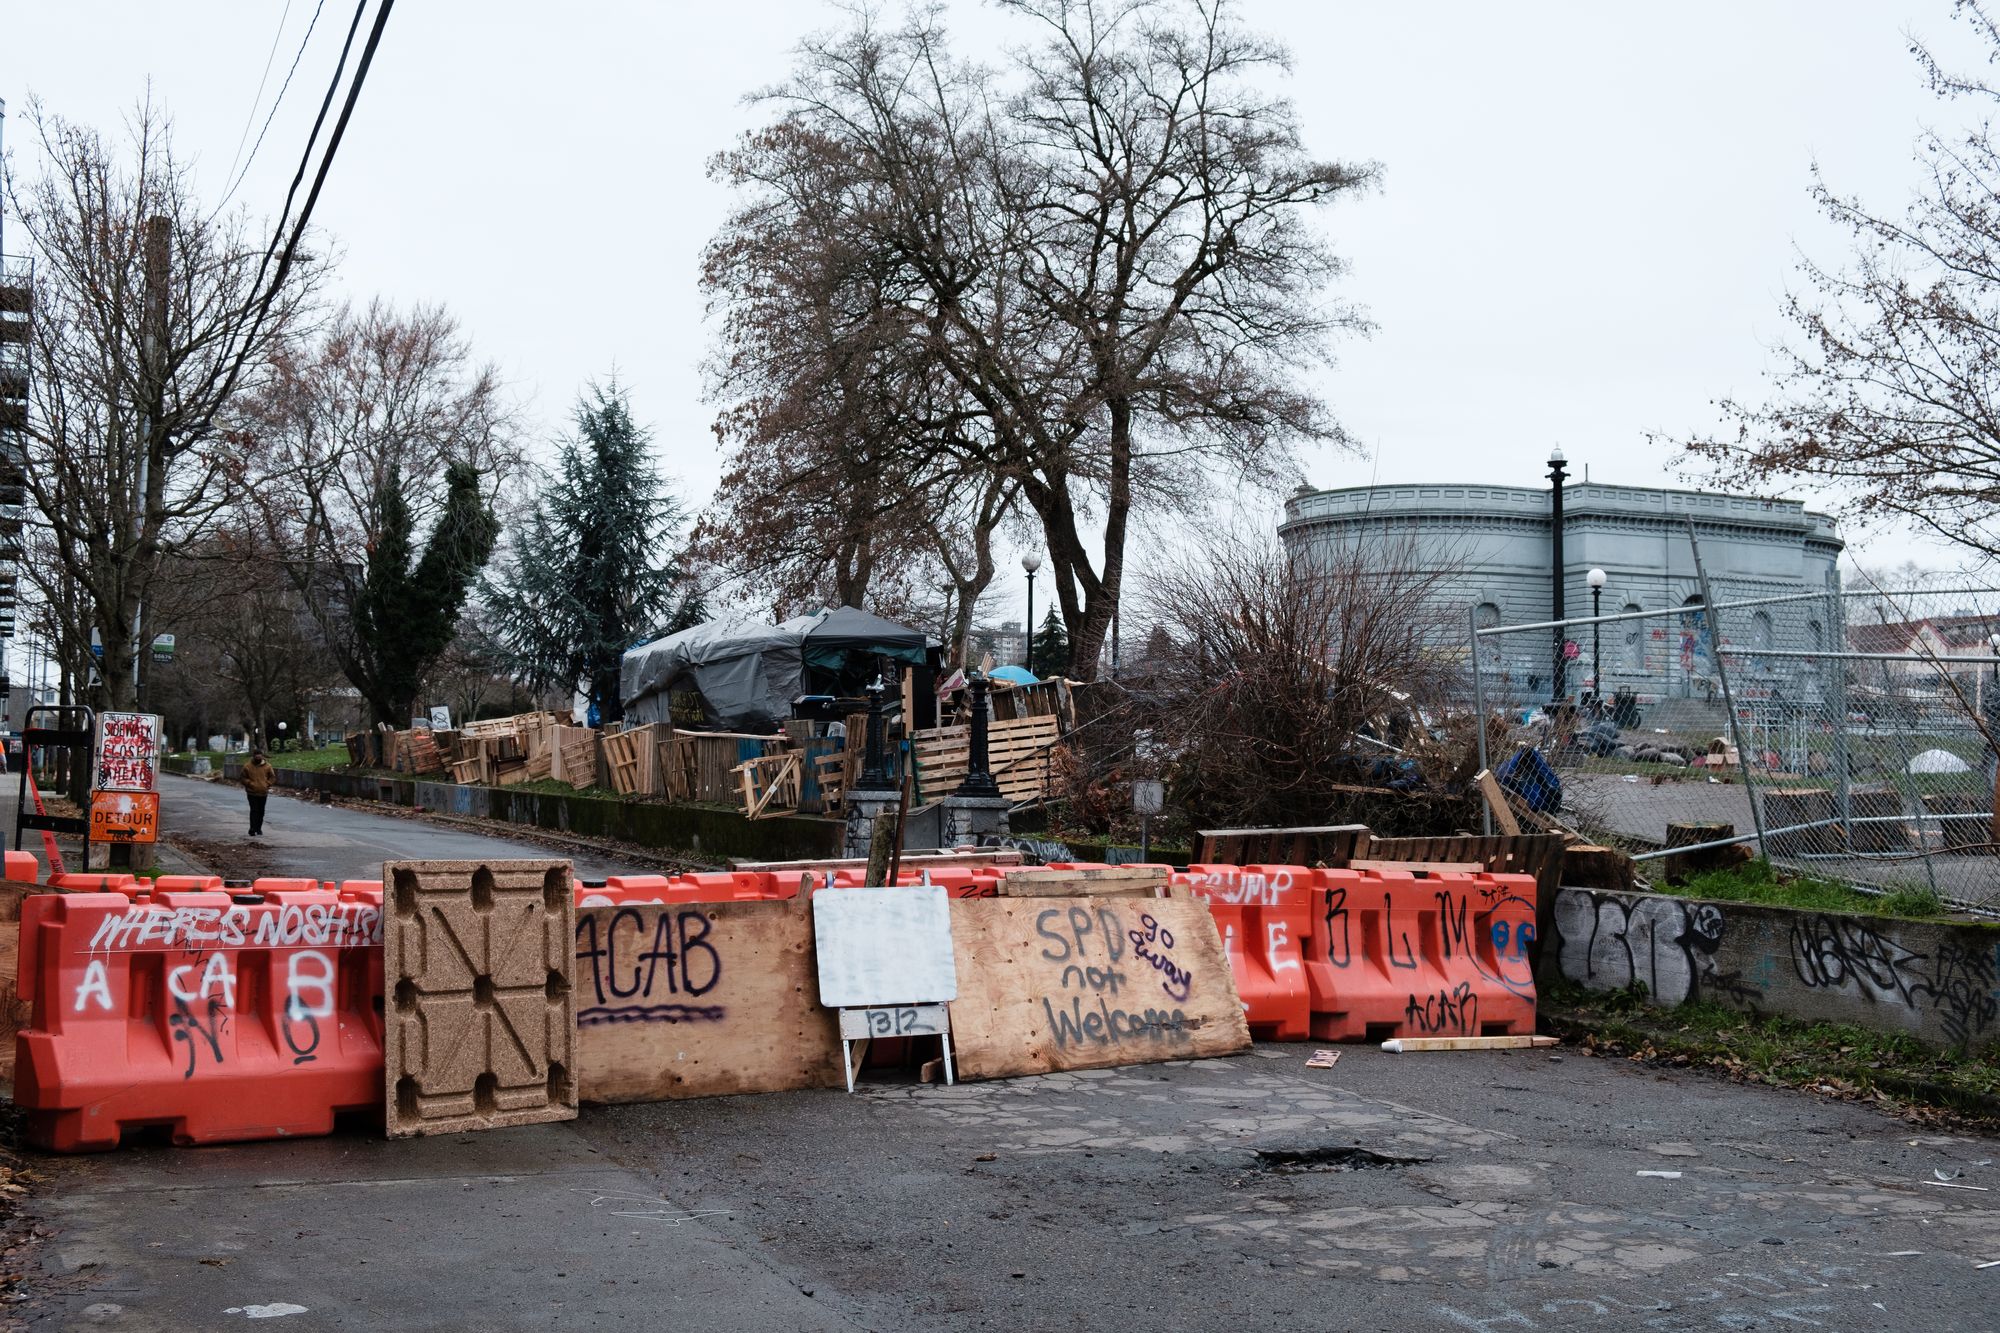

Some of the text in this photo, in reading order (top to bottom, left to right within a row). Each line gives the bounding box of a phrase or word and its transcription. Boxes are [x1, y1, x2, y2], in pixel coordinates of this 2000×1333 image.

[103, 722, 153, 738] SIDEWALK
[94, 811, 153, 825] DETOUR
[1185, 869, 1294, 906] TRUMP
[1036, 906, 1127, 962] SPD
[573, 907, 722, 1004] ACAB
[1062, 964, 1127, 996] not
[865, 1009, 936, 1038] 1312
[1404, 980, 1479, 1037] ACAB
